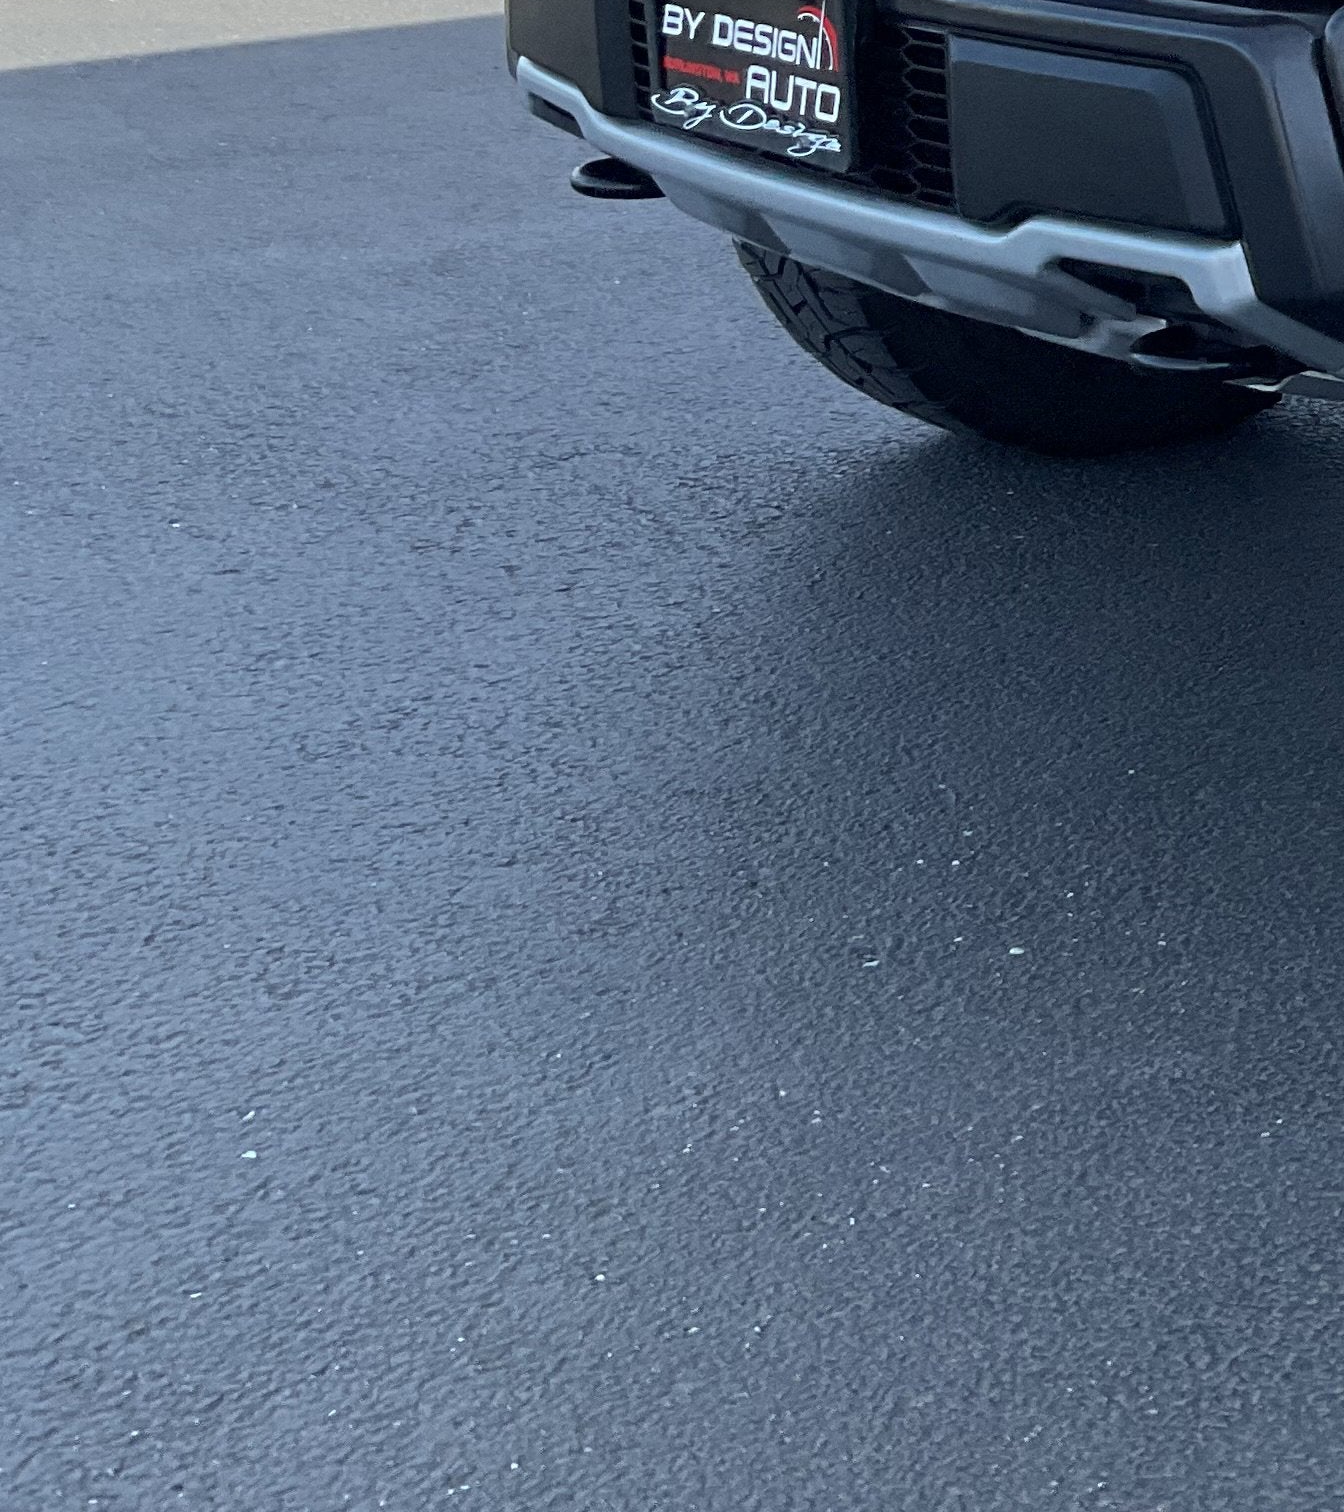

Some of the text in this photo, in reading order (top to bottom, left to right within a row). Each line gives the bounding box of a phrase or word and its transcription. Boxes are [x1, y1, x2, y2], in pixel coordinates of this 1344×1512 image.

[662, 3, 705, 39] BY
[712, 13, 820, 70] DESIGN
[651, 87, 716, 130] By
[745, 65, 841, 123] AUTO
